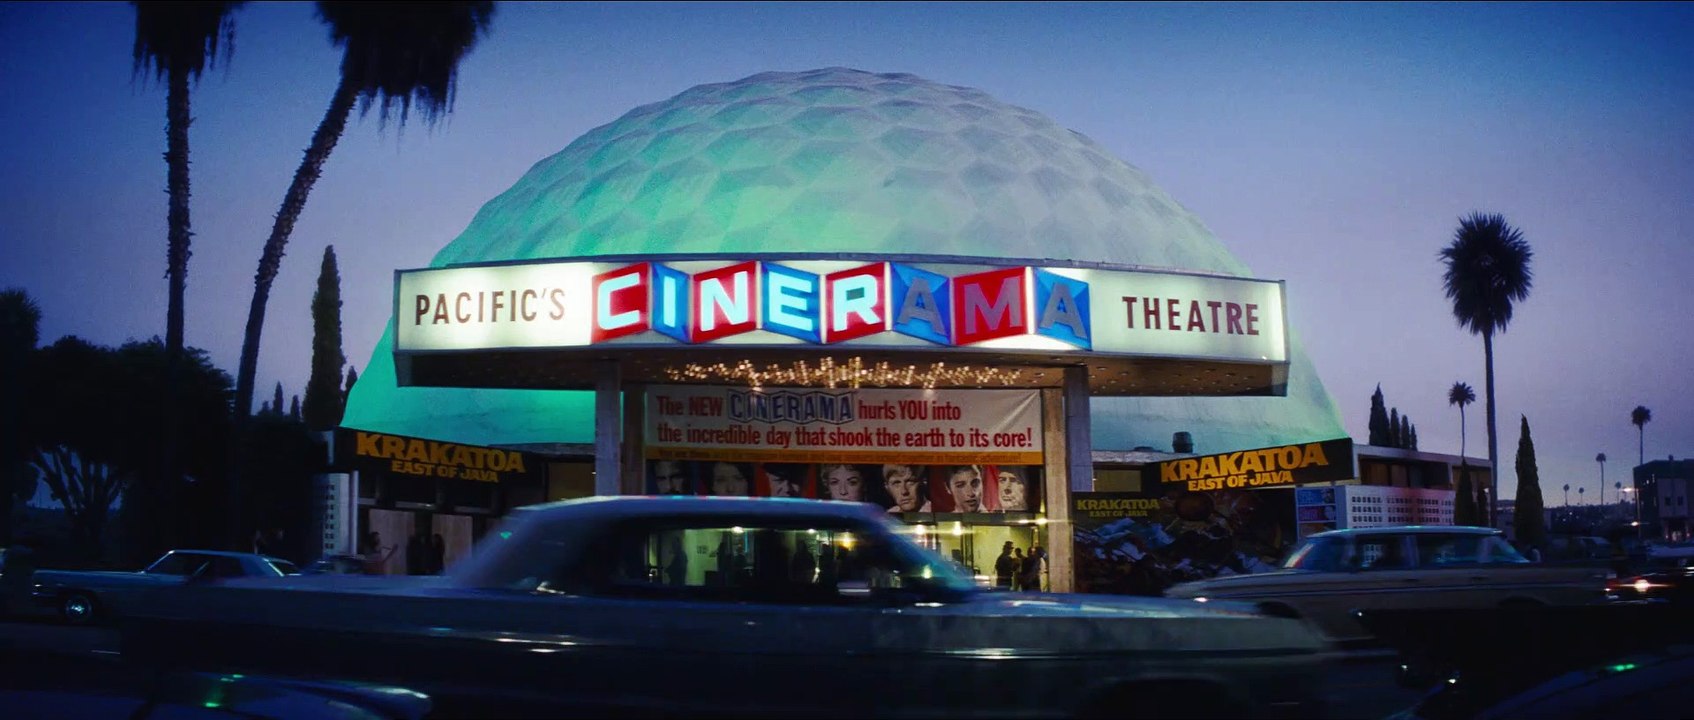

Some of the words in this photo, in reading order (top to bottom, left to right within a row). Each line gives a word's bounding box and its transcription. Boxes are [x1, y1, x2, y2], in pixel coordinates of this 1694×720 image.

[415, 288, 566, 326] PACIFIC'S
[596, 269, 1089, 340] CINERAMA
[1122, 295, 1260, 337] THEATRE
[656, 395, 683, 416] The
[688, 396, 724, 417] NEW
[729, 392, 851, 421] CINERAMA
[858, 400, 896, 420] hurls
[899, 400, 928, 420] YOU
[931, 401, 962, 420] into
[657, 422, 682, 443] the
[687, 423, 761, 446] incredible
[766, 425, 792, 449] day
[795, 426, 827, 446] that
[830, 427, 873, 447] shook
[876, 427, 900, 447] the
[905, 428, 945, 447] earth
[949, 428, 964, 447] to
[969, 428, 989, 447] its
[993, 427, 1032, 447] core!
[356, 432, 526, 473] KRAKATOA
[1160, 442, 1329, 483] KRAKATOA
[391, 460, 433, 477] EAST
[437, 466, 457, 478] OF
[460, 468, 499, 483] JAVA
[1187, 477, 1226, 492] EAST
[1226, 474, 1249, 488] OF
[1249, 470, 1294, 485] JAVA
[1076, 498, 1160, 510] KRAKATOA
